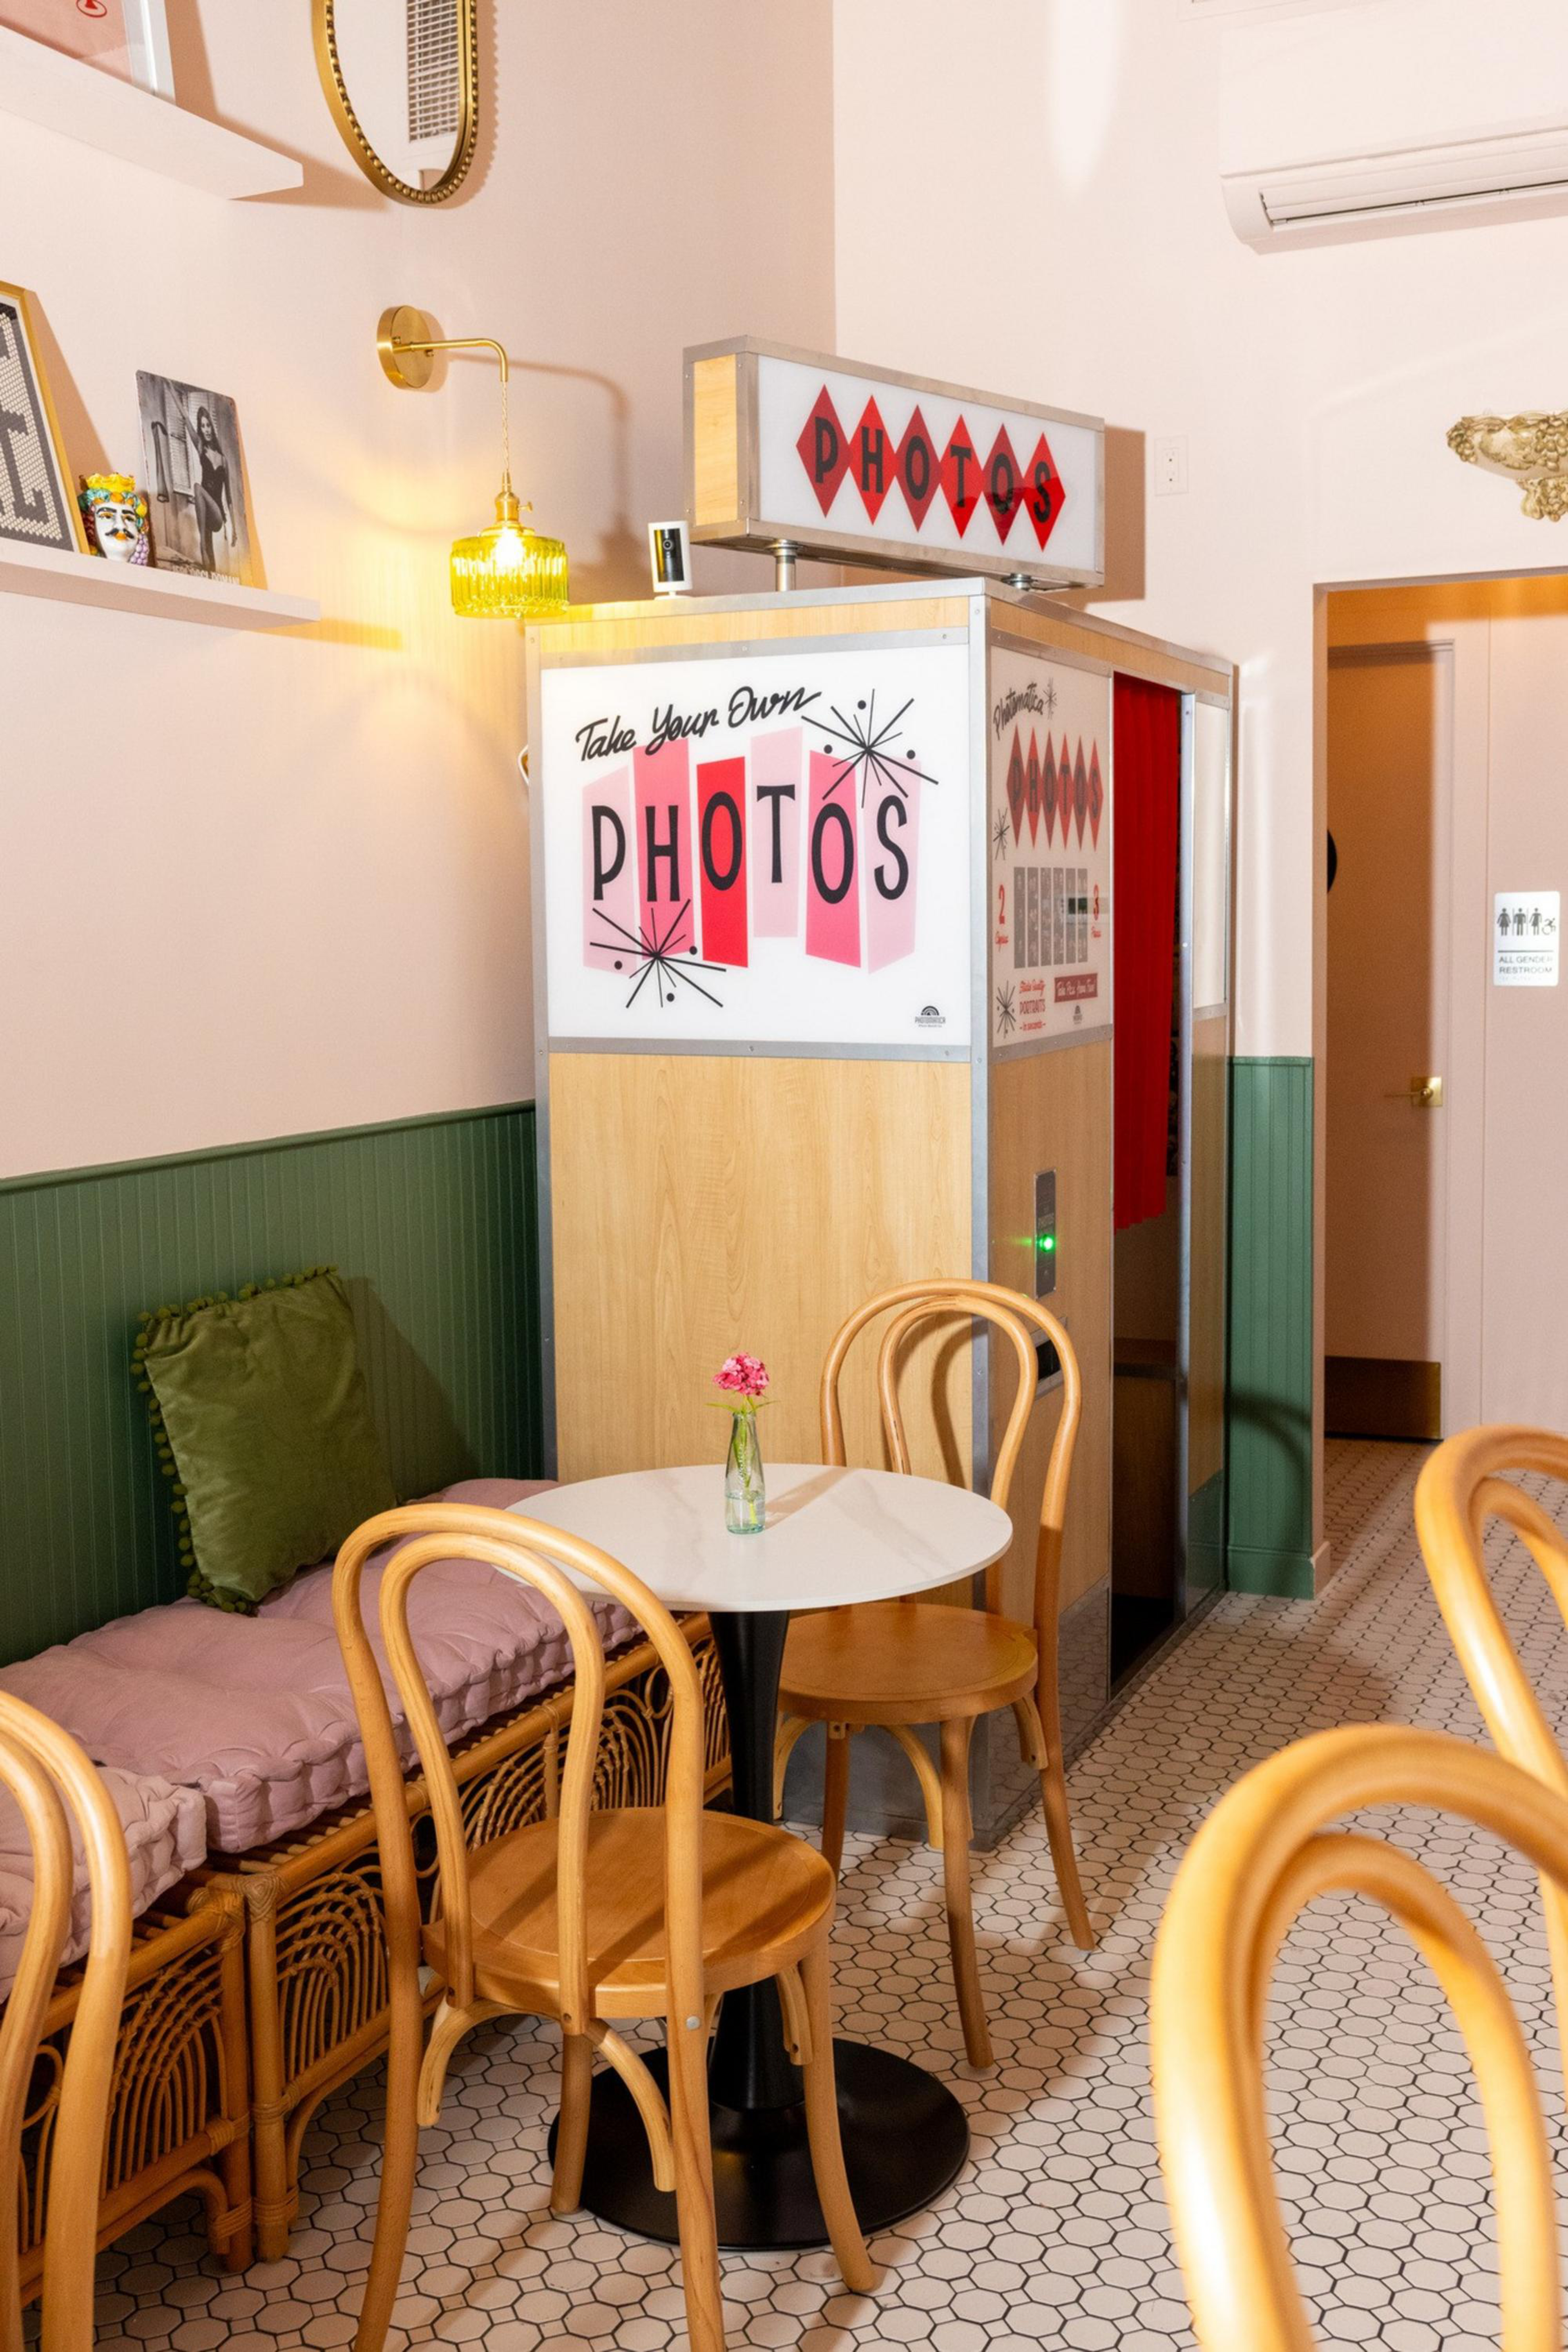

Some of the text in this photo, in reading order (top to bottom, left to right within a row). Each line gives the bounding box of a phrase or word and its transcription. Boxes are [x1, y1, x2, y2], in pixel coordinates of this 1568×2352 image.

[815, 416, 1051, 523] PHOTOS
[575, 686, 822, 761] Take Your Own
[993, 681, 1044, 741] Photomatica
[1013, 757, 1098, 819] PHOTOS
[591, 784, 909, 905] PHOTOS
[999, 884, 1005, 925] 2
[1093, 884, 1099, 921] 3
[1019, 998, 1046, 1015] PORTRAITS
